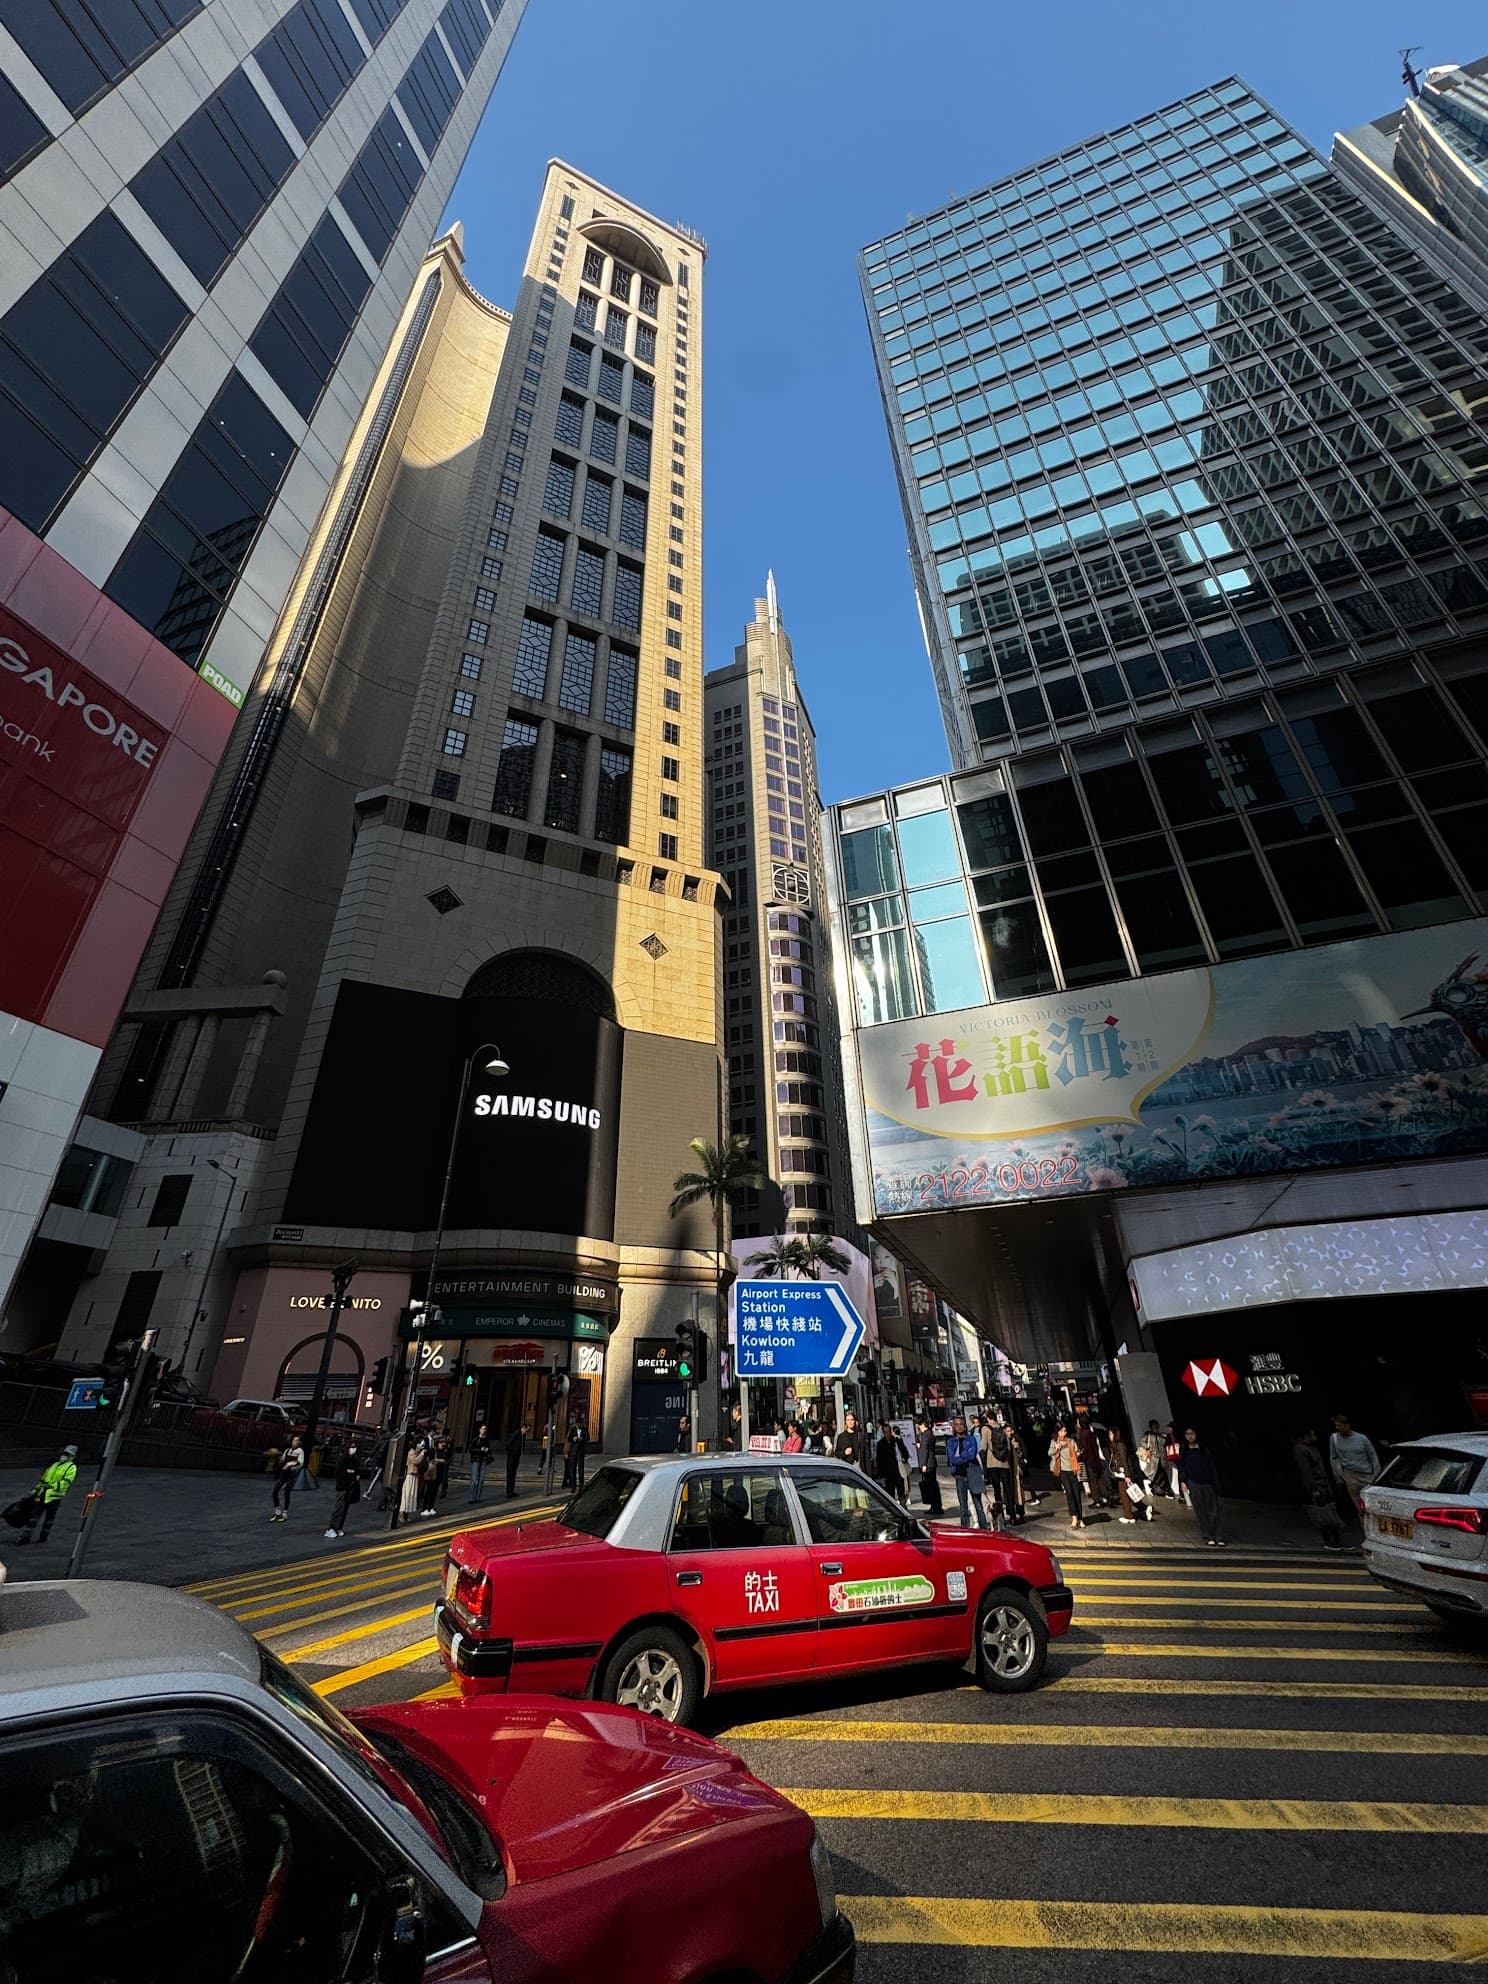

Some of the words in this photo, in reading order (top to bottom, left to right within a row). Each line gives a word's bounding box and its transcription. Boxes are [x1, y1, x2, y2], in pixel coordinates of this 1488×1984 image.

[203, 664, 242, 704] POAD
[0, 636, 158, 768] GAPORE
[0, 714, 56, 762] ank
[959, 1013, 1030, 1033] VICTORIA
[1037, 999, 1112, 1021] BLOSSOM
[474, 1094, 601, 1129] SAMSUNG
[919, 1167, 988, 1200] 2122
[1000, 1157, 1082, 1191] 0022
[434, 1281, 550, 1294] ENTERTAINMENT
[557, 1283, 606, 1299] BUILDING
[741, 1288, 778, 1299] Airport
[782, 1288, 822, 1301] Express
[741, 1302, 786, 1314] Station
[475, 1317, 514, 1326] EMPEROR
[532, 1319, 566, 1328] CINEMAS
[743, 1316, 822, 1332] 機場快綫站
[741, 1335, 796, 1348] Kowloon
[743, 1350, 775, 1366] 九龍
[1244, 1373, 1302, 1394] HSBC
[744, 1570, 778, 1591] 的士
[745, 1591, 779, 1613] TAXI
